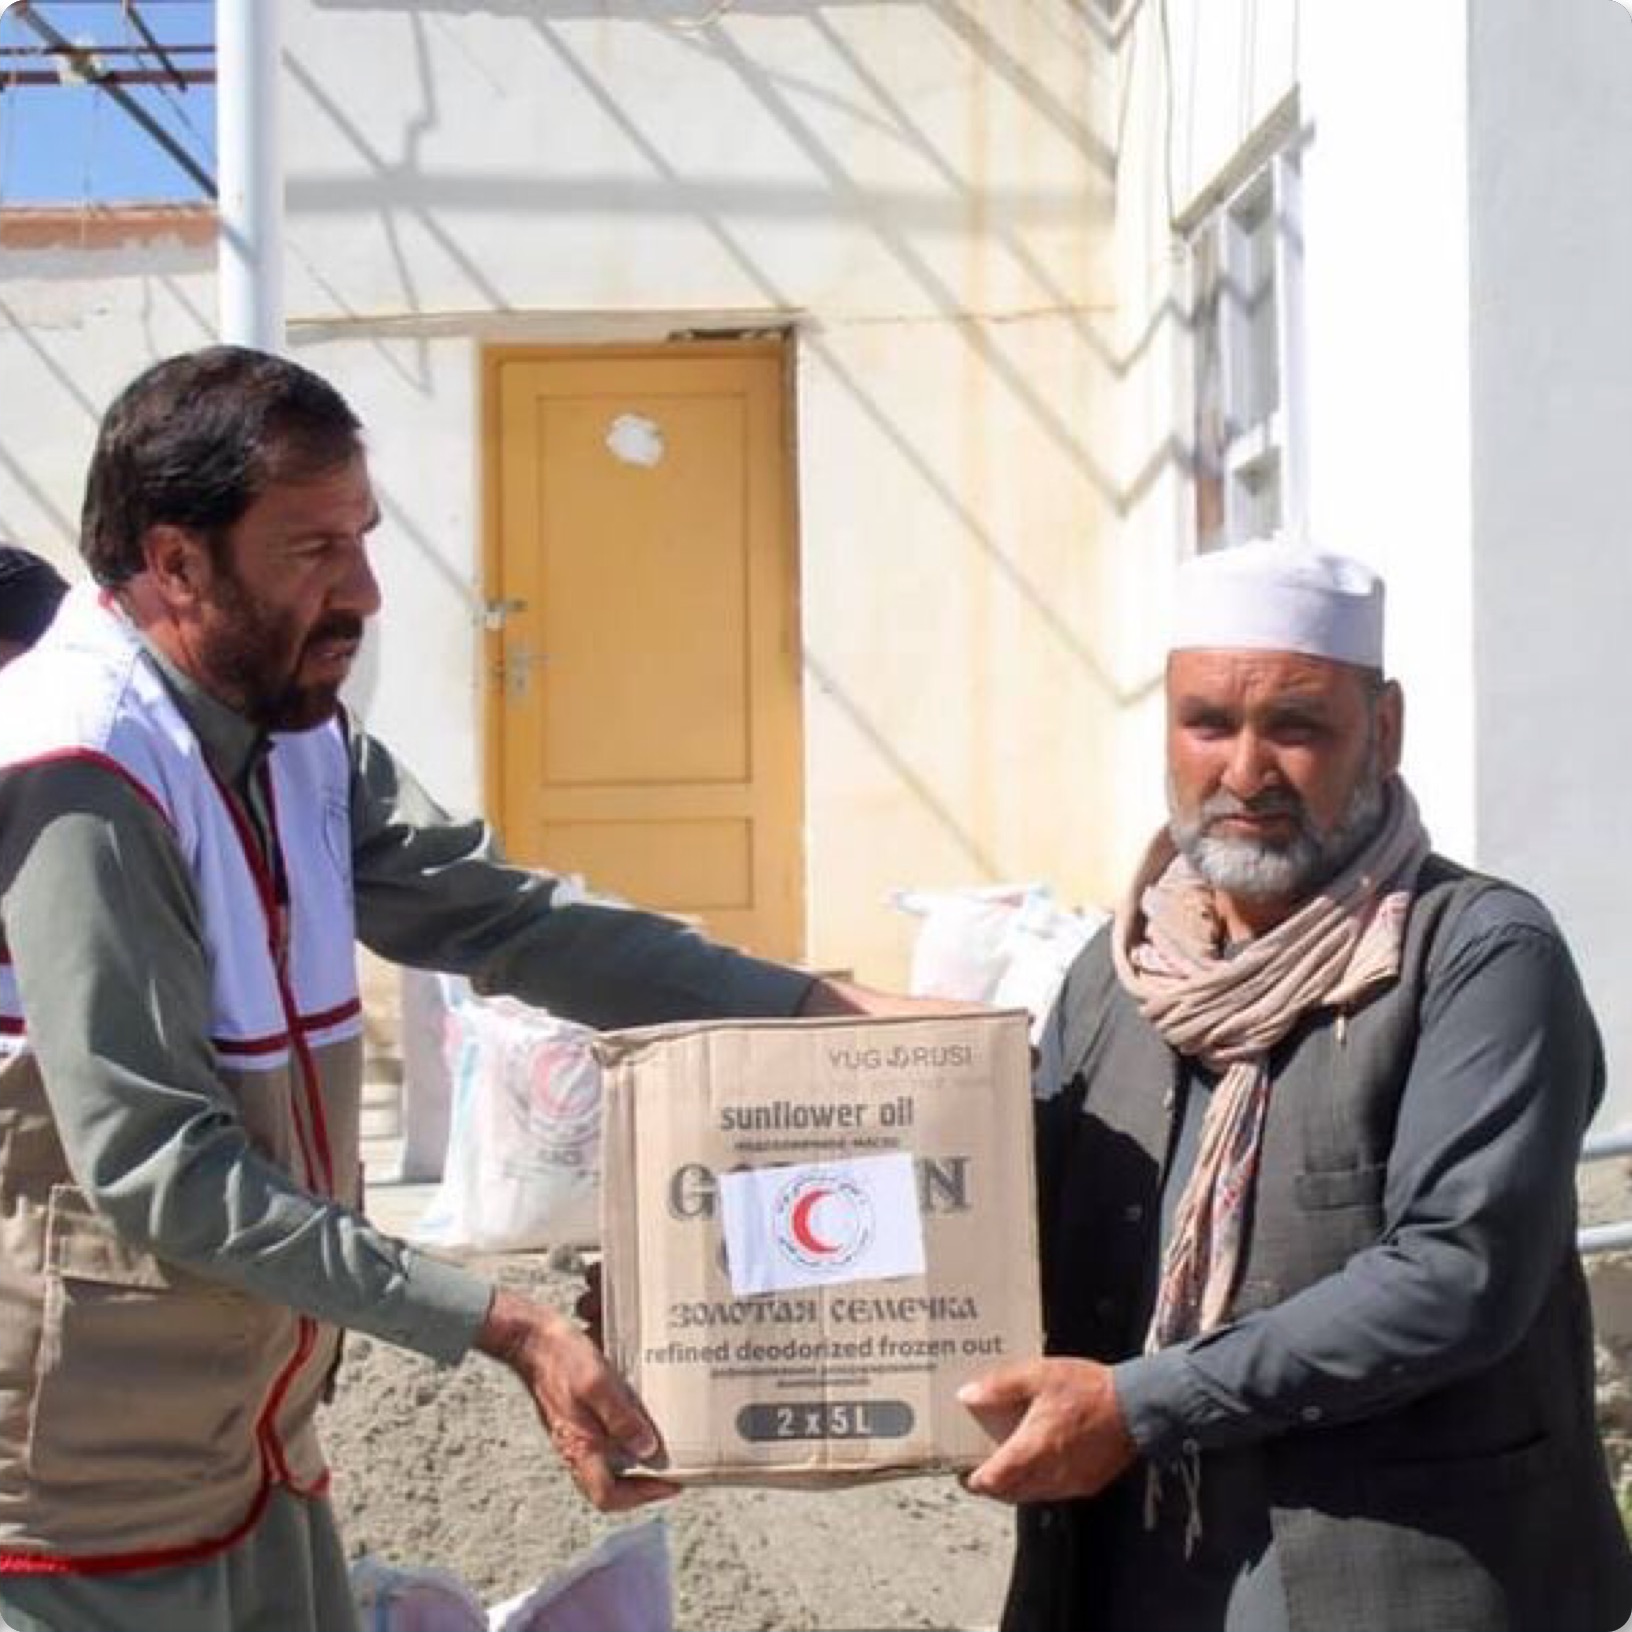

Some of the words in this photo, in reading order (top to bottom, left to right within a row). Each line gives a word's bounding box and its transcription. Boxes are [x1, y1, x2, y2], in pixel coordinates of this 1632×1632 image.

[829, 1049, 881, 1069] YUG
[913, 1045, 972, 1067] RUSI
[721, 1101, 868, 1131] sunflower
[880, 1096, 914, 1128] oil
[645, 1342, 730, 1363] refined
[736, 1336, 872, 1362] deodorized
[880, 1335, 956, 1358] frozen
[962, 1335, 1003, 1355] out
[777, 1407, 795, 1436] 2
